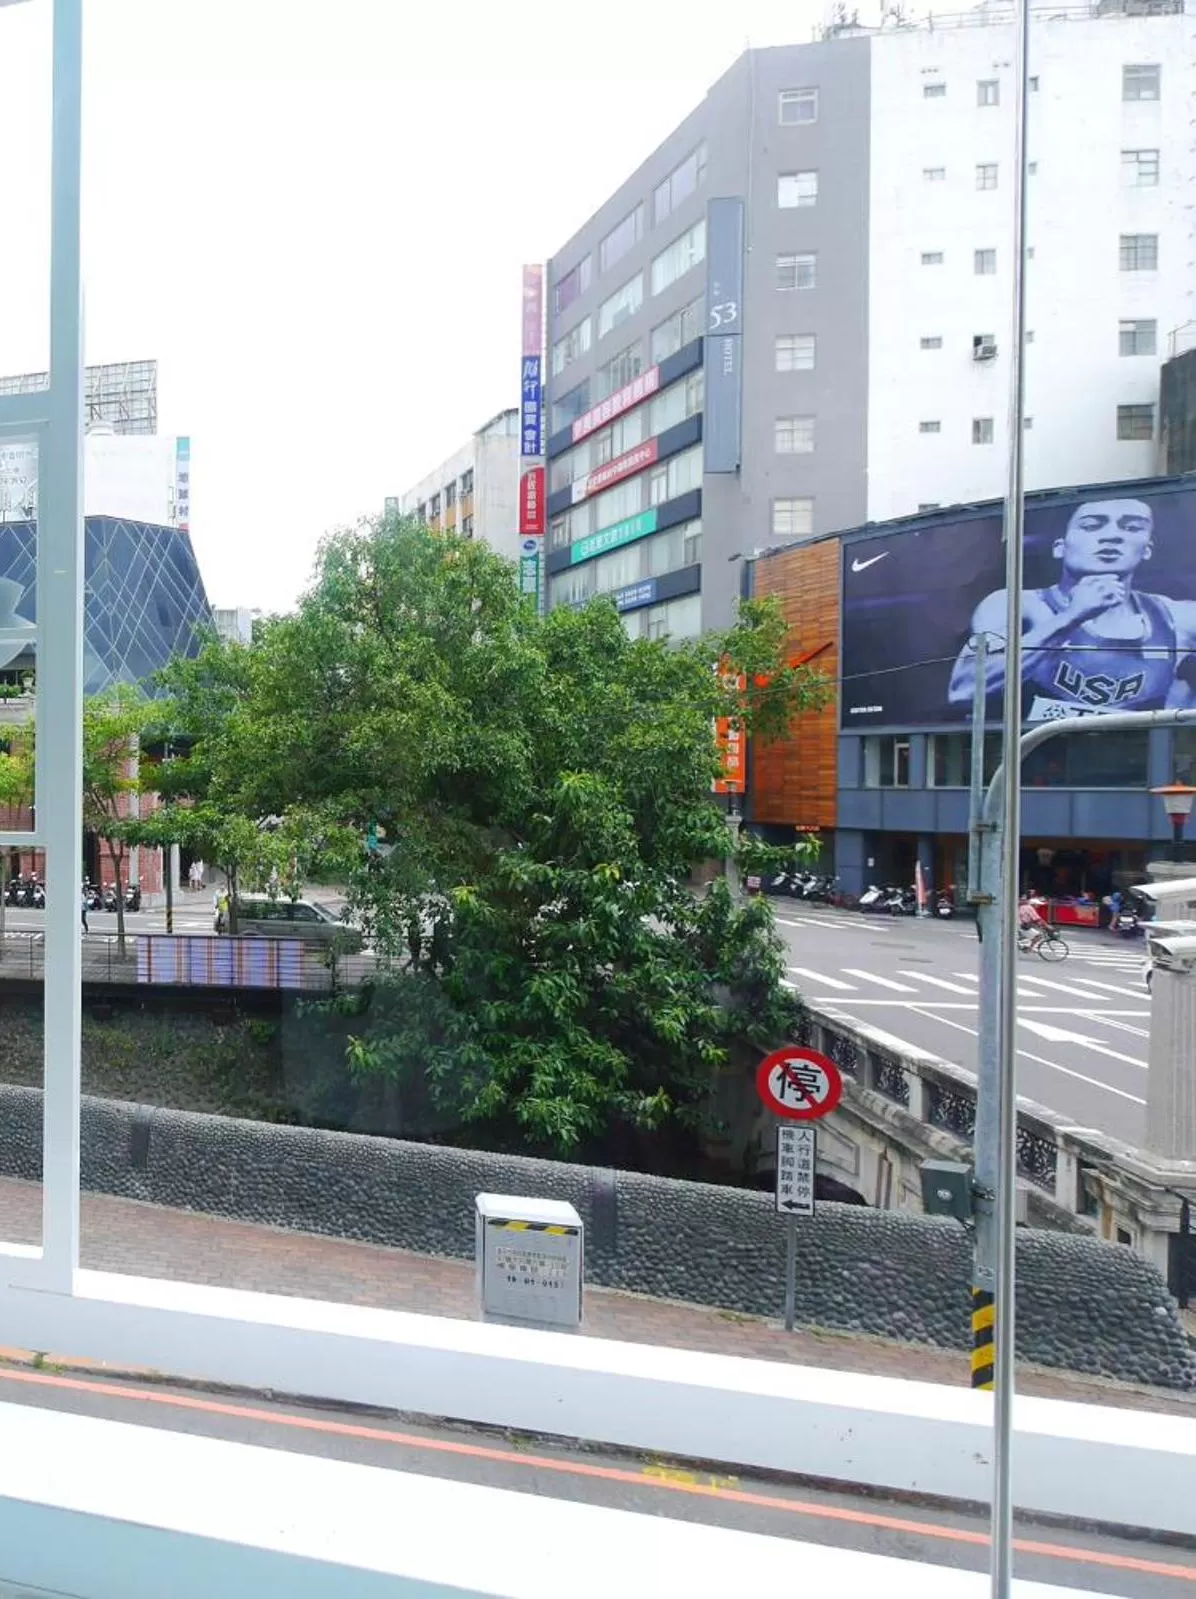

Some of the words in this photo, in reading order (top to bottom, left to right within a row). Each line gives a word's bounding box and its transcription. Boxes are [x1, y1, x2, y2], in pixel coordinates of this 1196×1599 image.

[708, 300, 737, 330] 53
[1053, 660, 1145, 706] USA
[776, 1063, 821, 1102] 停
